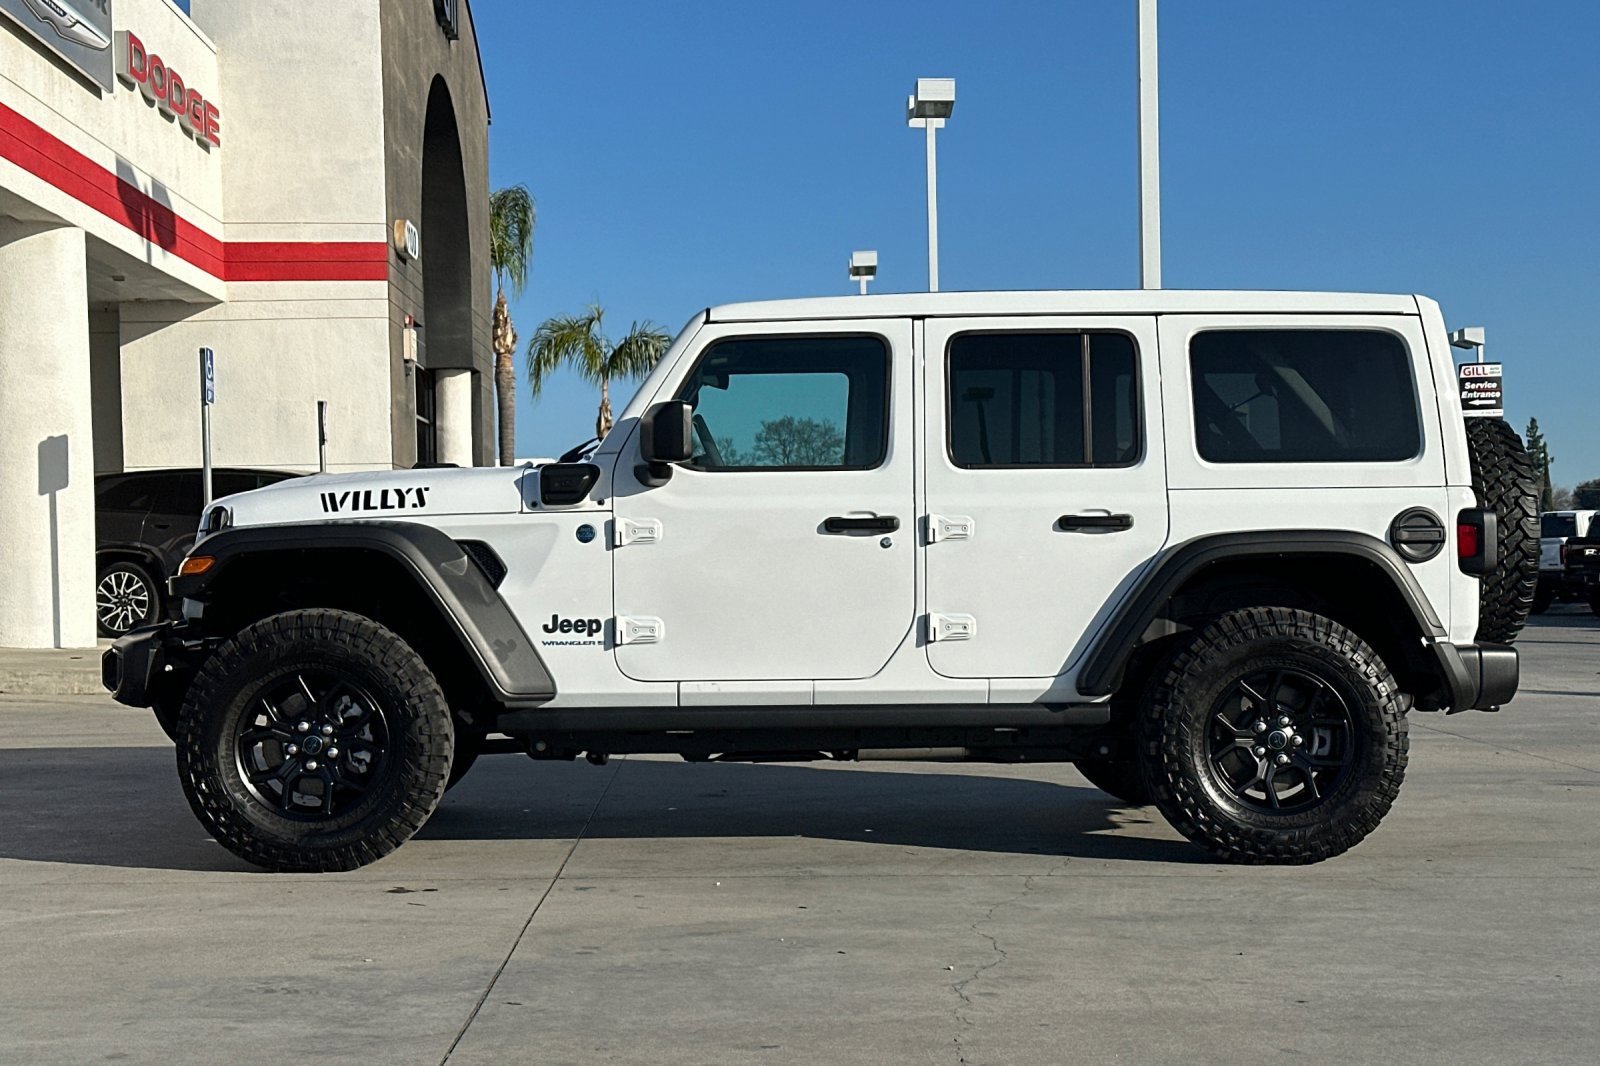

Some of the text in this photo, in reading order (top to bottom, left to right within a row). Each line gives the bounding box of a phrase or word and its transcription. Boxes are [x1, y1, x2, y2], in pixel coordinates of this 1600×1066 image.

[127, 30, 220, 148] DODGE
[1463, 366, 1488, 376] GILL
[1464, 381, 1498, 389] Service
[1461, 390, 1501, 398] Entrance
[320, 487, 430, 513] WILLYS
[542, 613, 602, 637] Jeep
